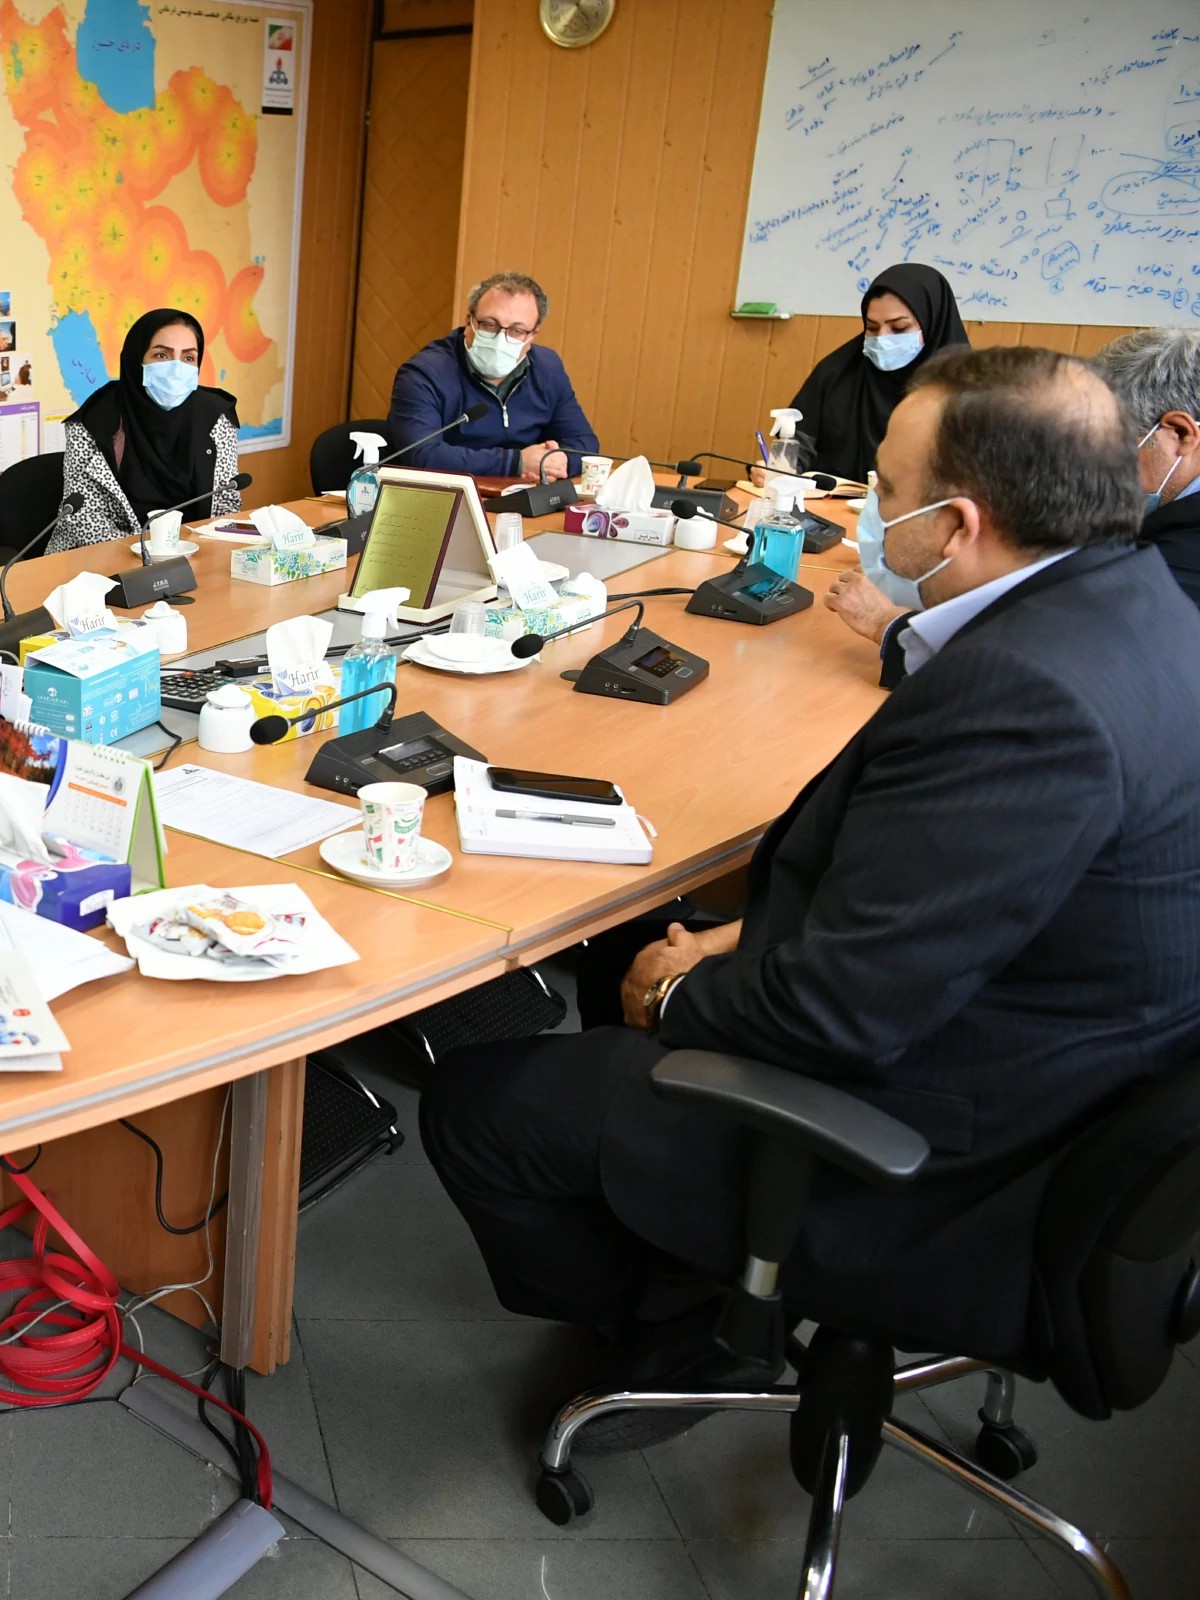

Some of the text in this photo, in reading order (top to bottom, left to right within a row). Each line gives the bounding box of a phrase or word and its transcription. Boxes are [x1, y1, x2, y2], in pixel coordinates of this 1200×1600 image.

[281, 529, 305, 545] Harir
[523, 586, 547, 603] Harir
[80, 614, 105, 632] Harir
[288, 666, 320, 688] Harir
